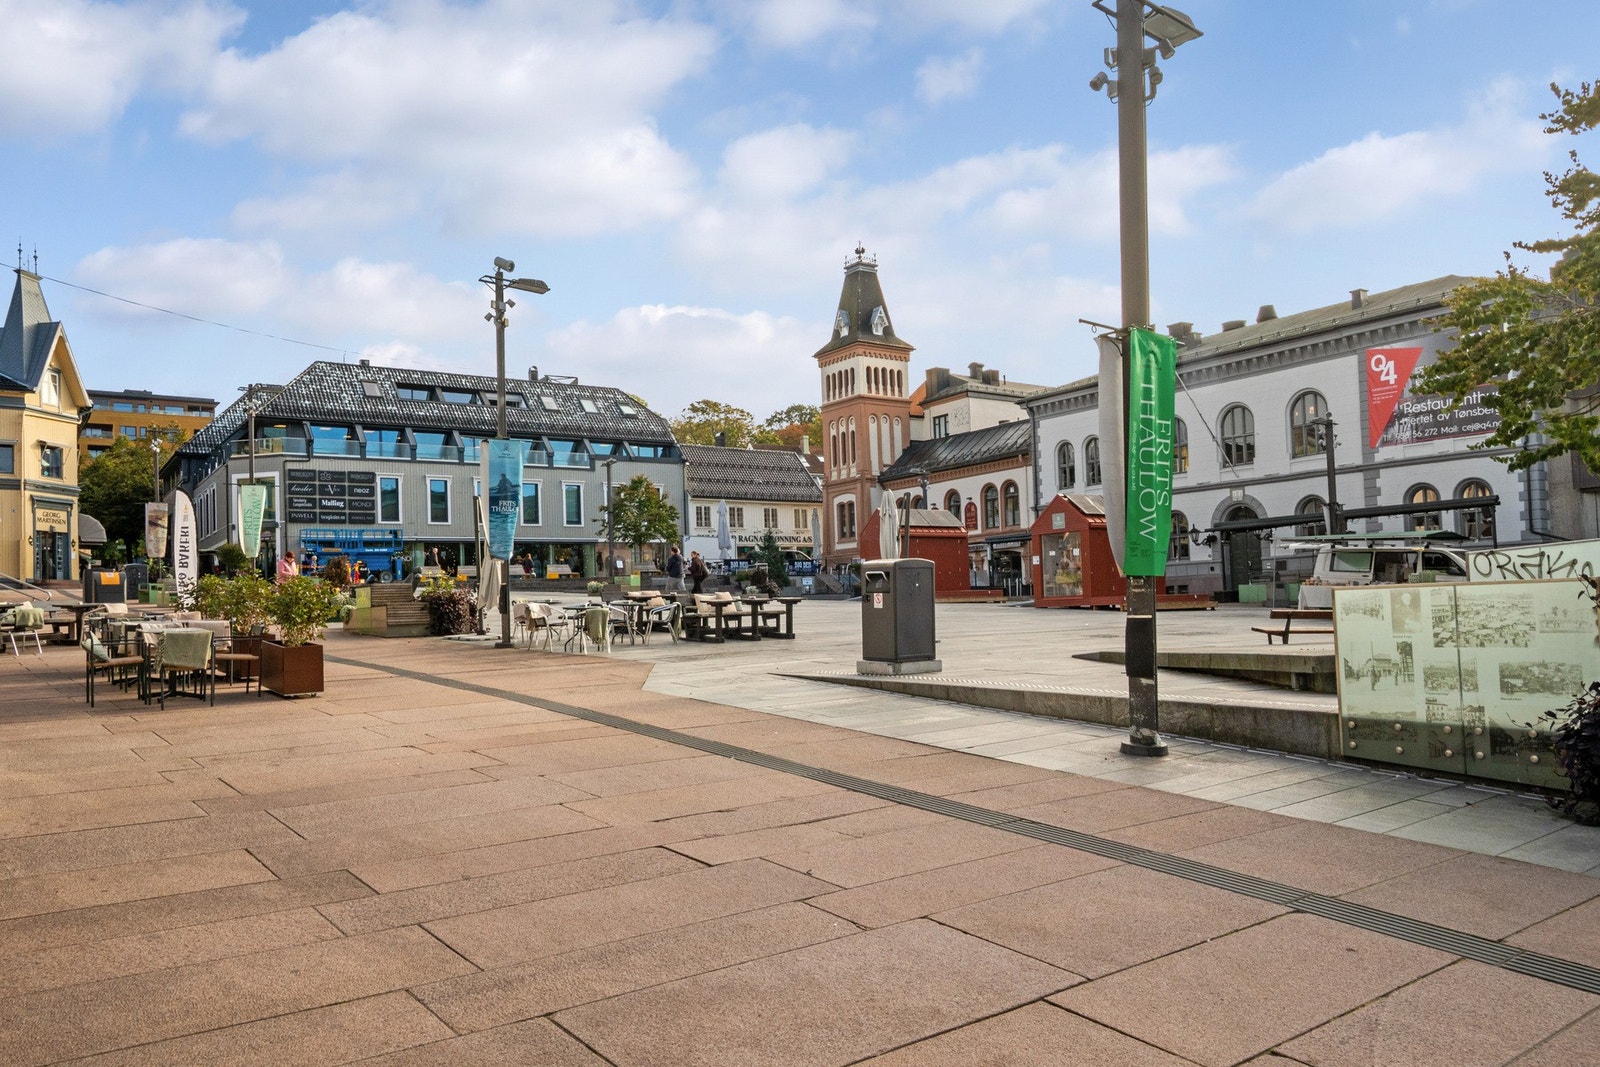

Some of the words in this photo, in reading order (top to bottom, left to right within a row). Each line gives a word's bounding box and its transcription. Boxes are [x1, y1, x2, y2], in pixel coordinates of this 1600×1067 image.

[1371, 354, 1397, 385] Q4
[1424, 428, 1438, 436] 272
[1139, 375, 1157, 543] THAULOW
[1156, 418, 1171, 506] FRITS
[321, 500, 345, 508] Malling
[37, 517, 67, 525] MARTINSEN
[244, 509, 252, 536] FRITS
